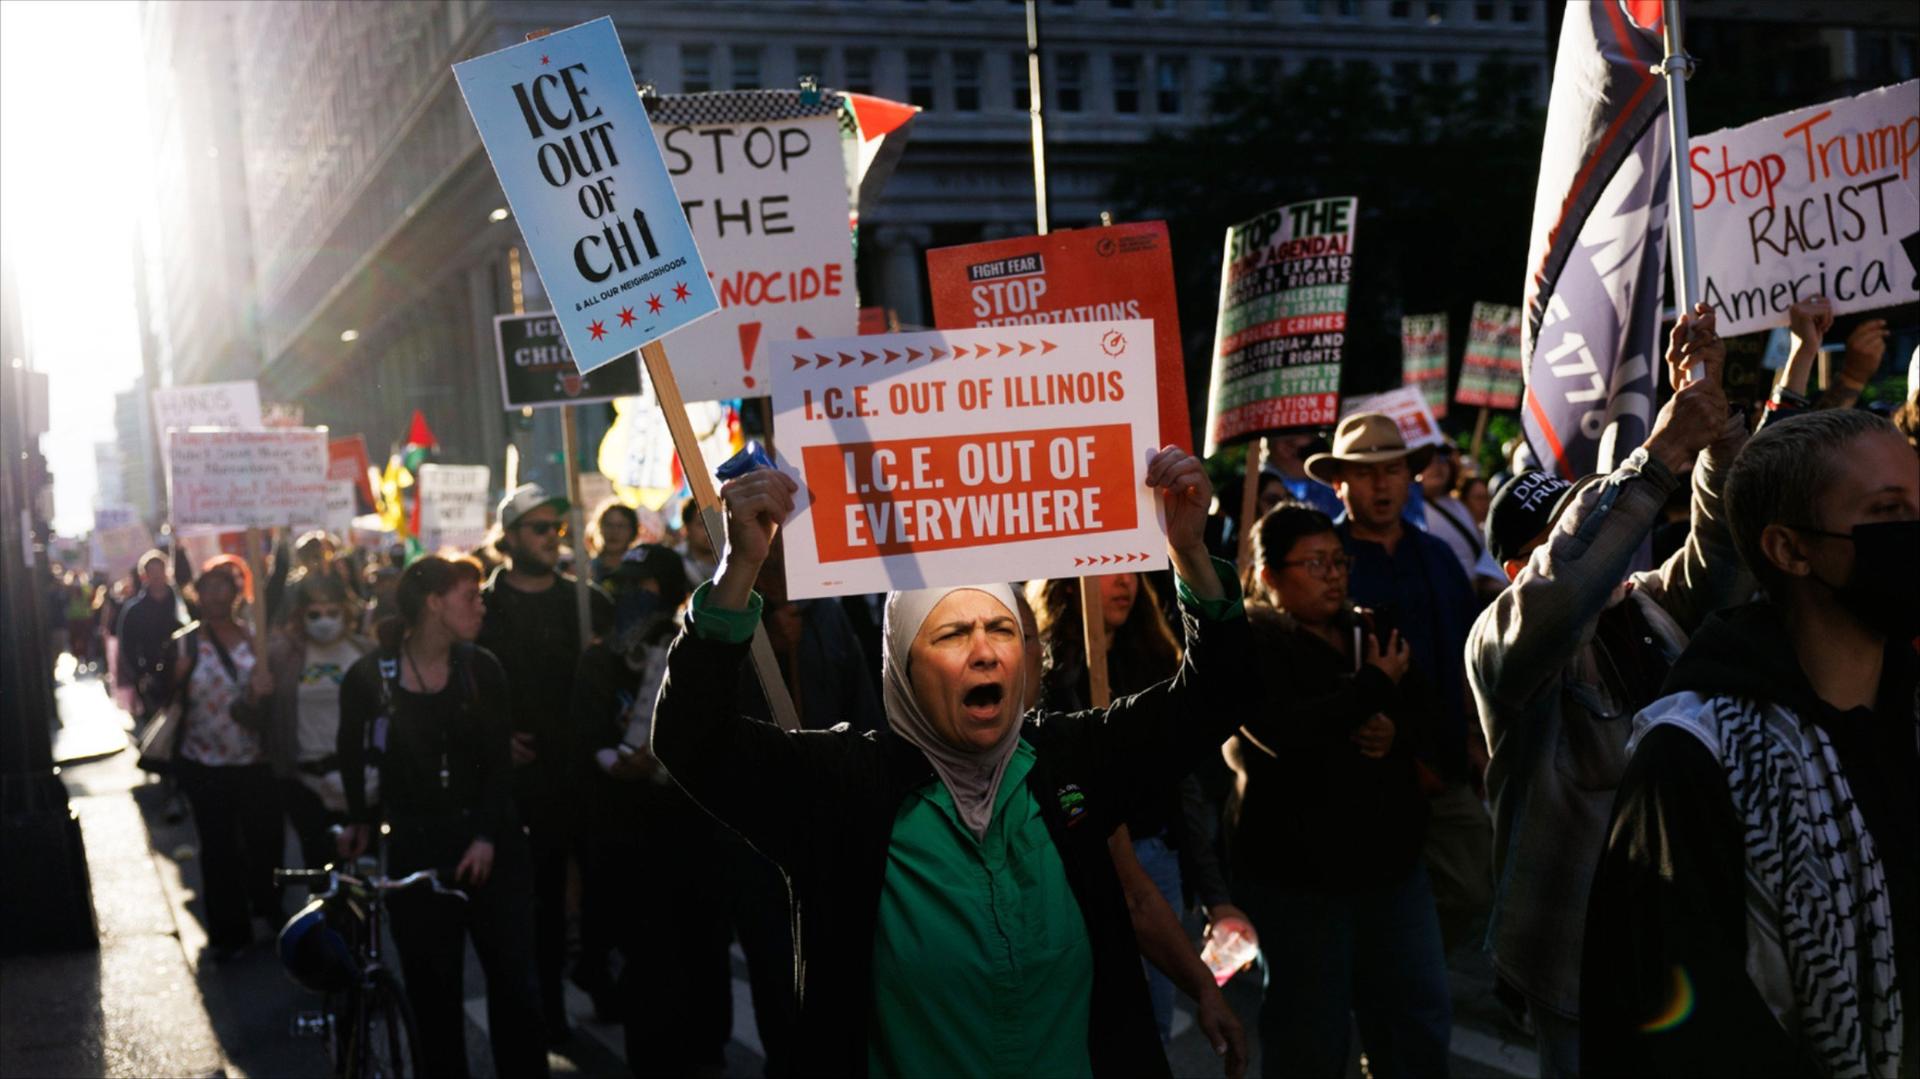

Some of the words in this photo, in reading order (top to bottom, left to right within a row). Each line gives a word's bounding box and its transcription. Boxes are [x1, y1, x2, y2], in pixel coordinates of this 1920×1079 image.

[511, 62, 603, 139] ICE
[537, 121, 620, 188] OUT
[664, 126, 811, 176] STOP
[1689, 145, 1786, 210] Stop
[1783, 110, 1920, 184] Trump
[578, 175, 616, 220] OF
[680, 195, 795, 239] THE
[1289, 200, 1351, 239] THE
[1748, 174, 1900, 265] RACIST
[574, 207, 661, 284] CHI
[972, 260, 1005, 279] FIGHT
[1007, 256, 1036, 274] FEAR
[1283, 256, 1351, 276] EXPAND
[575, 302, 582, 312] &
[583, 293, 600, 310] ALL
[600, 287, 619, 301] OUR
[620, 256, 688, 293] NEIGHBORHOODS
[708, 263, 842, 309] NOCIDE
[970, 278, 1047, 319] STOP
[1275, 286, 1346, 305] PALESTINE
[1289, 270, 1351, 288] RIGHTS
[1704, 259, 1892, 324] America
[1287, 316, 1345, 333] CRIMES
[1295, 299, 1345, 315] ISRAEL
[1288, 348, 1342, 366] RIGHTS
[1311, 333, 1344, 348] AND
[1281, 378, 1339, 396] STRIKE
[1324, 365, 1340, 377] TO
[803, 385, 879, 422] I.C.E.
[889, 380, 947, 415] OUT
[958, 377, 993, 412] OF
[1004, 370, 1126, 408] ILLINOIS
[1263, 408, 1336, 428] FREEDOM
[844, 446, 945, 495] I.C.E.
[958, 440, 1035, 486] OUT
[1049, 435, 1096, 481] OF
[844, 486, 1104, 547] EVERYWHERE
